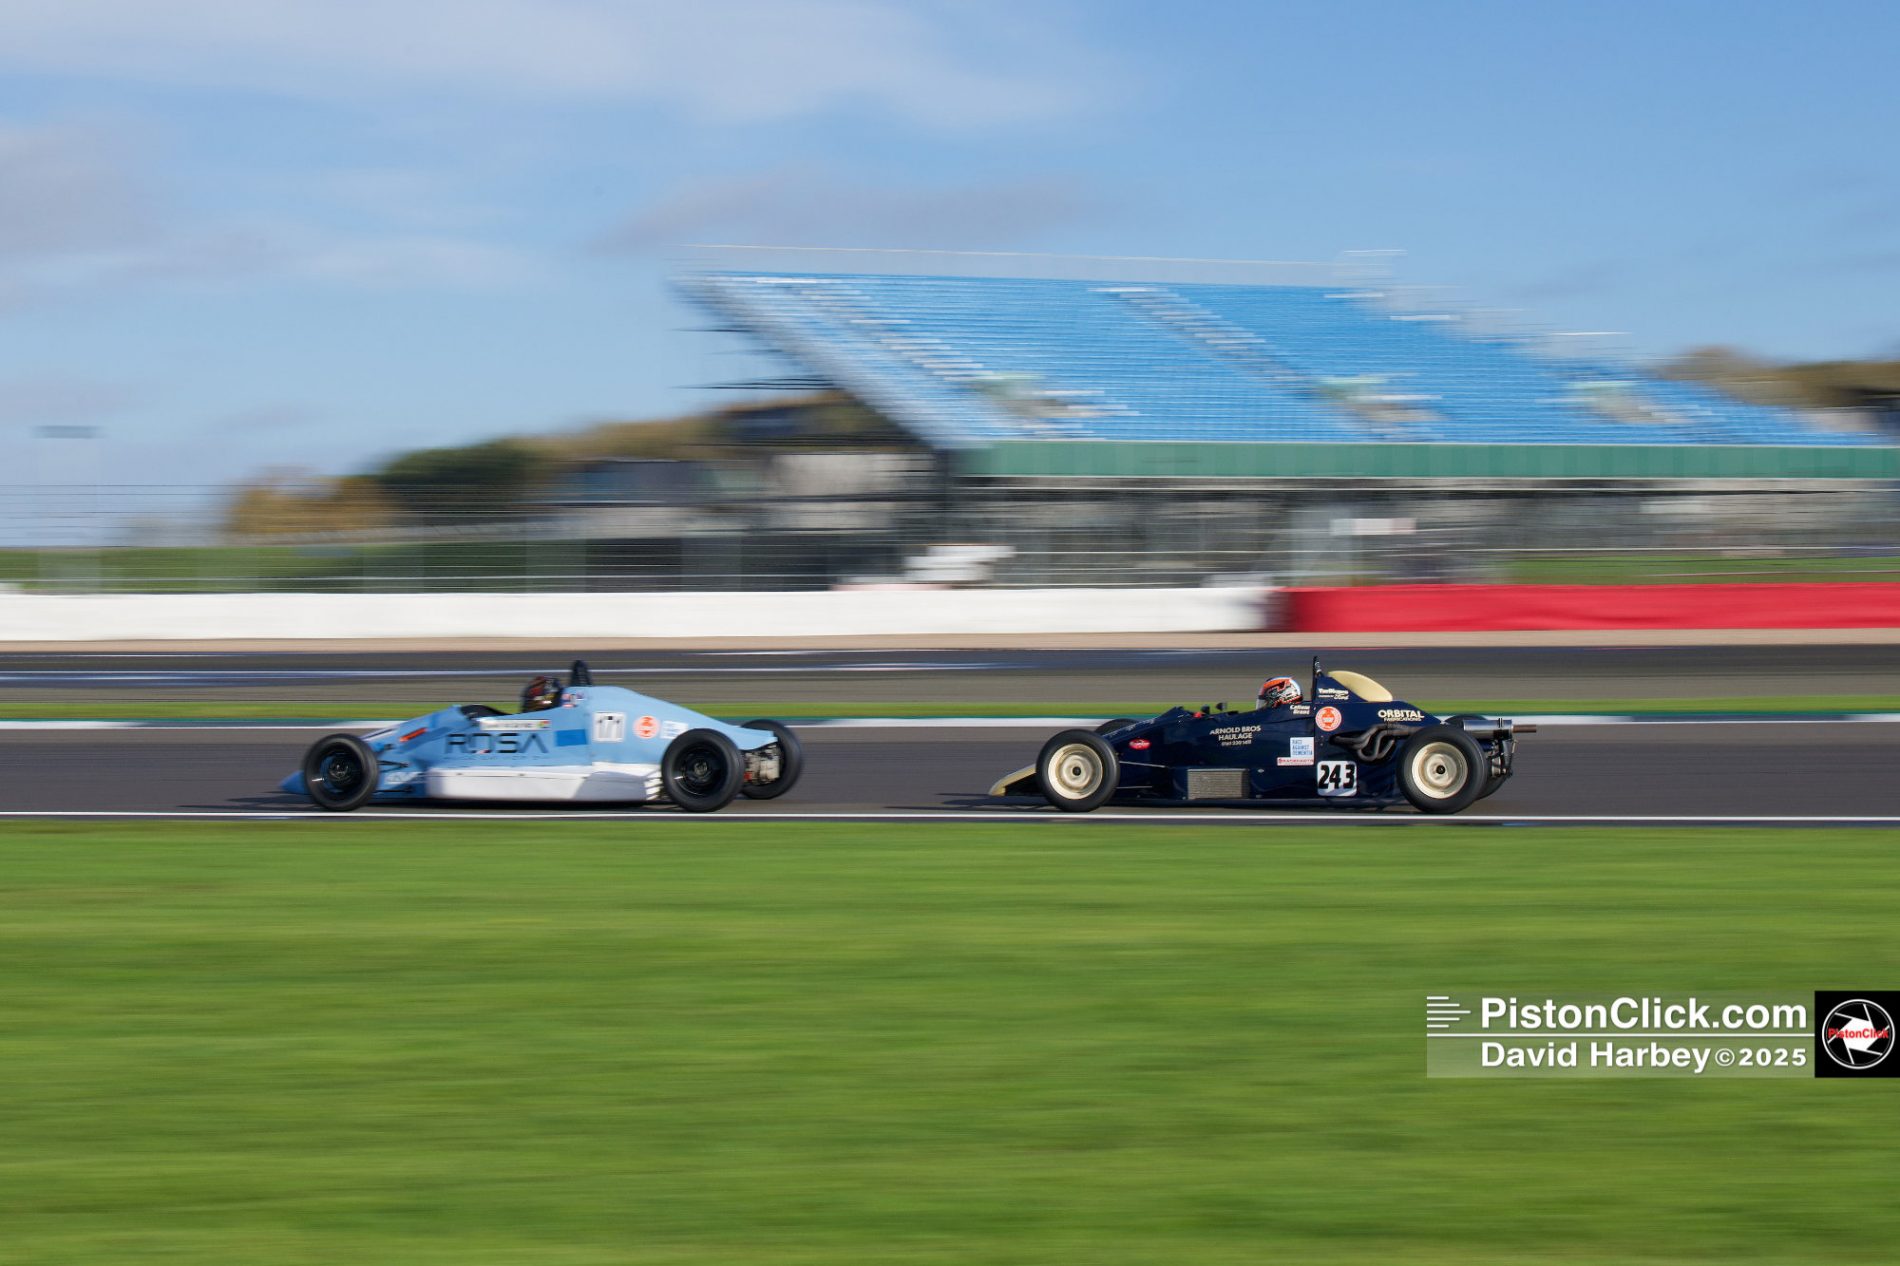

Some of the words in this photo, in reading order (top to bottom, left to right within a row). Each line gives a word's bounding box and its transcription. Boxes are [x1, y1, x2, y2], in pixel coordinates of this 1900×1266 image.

[1378, 709, 1425, 718] ORBITAL
[1209, 726, 1241, 735] ARNOLD
[1241, 725, 1261, 733] BROS
[1218, 732, 1253, 741] HAULAGE
[445, 732, 548, 754] ROSA
[1318, 764, 1355, 790] 243
